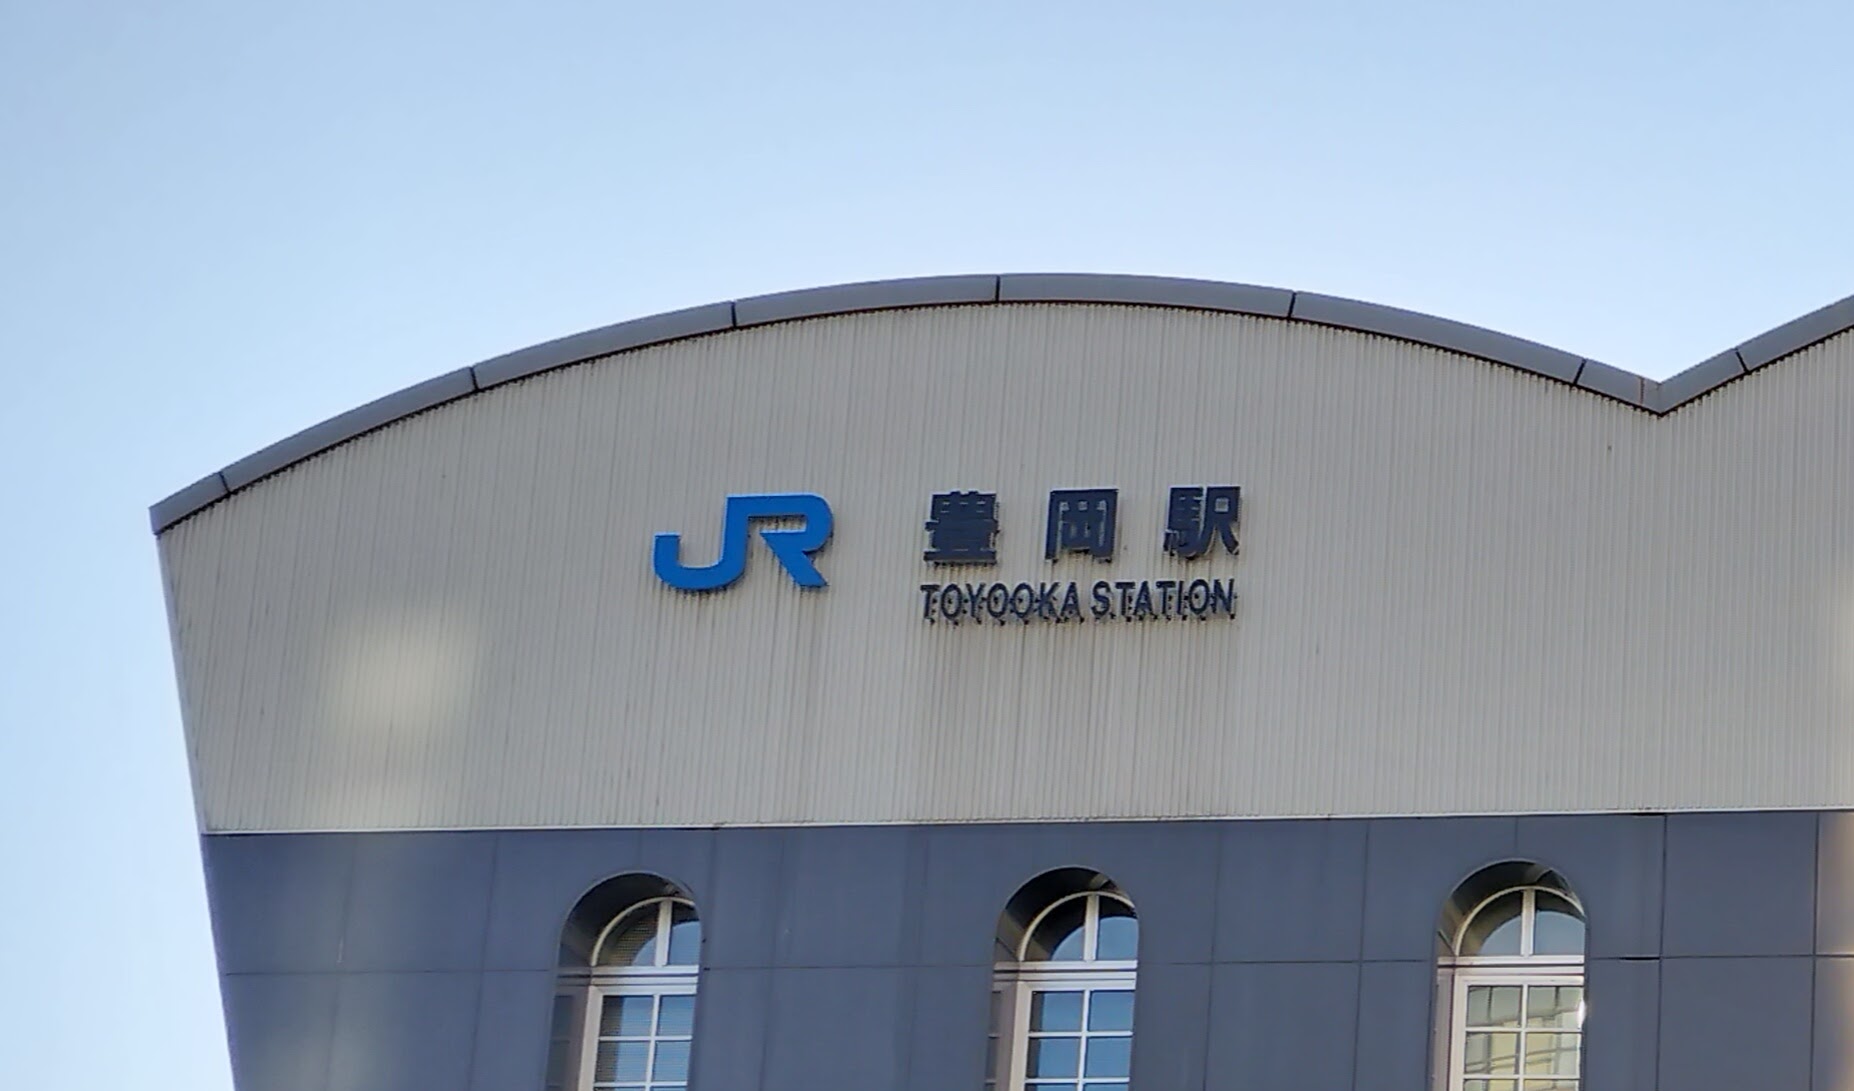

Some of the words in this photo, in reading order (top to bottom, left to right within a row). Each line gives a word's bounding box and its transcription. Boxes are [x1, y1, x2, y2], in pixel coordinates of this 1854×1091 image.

[652, 492, 834, 591] JR
[923, 485, 1241, 562] 豊岡駅
[921, 581, 1081, 620] TOYOOKA
[1090, 578, 1236, 617] STATION
